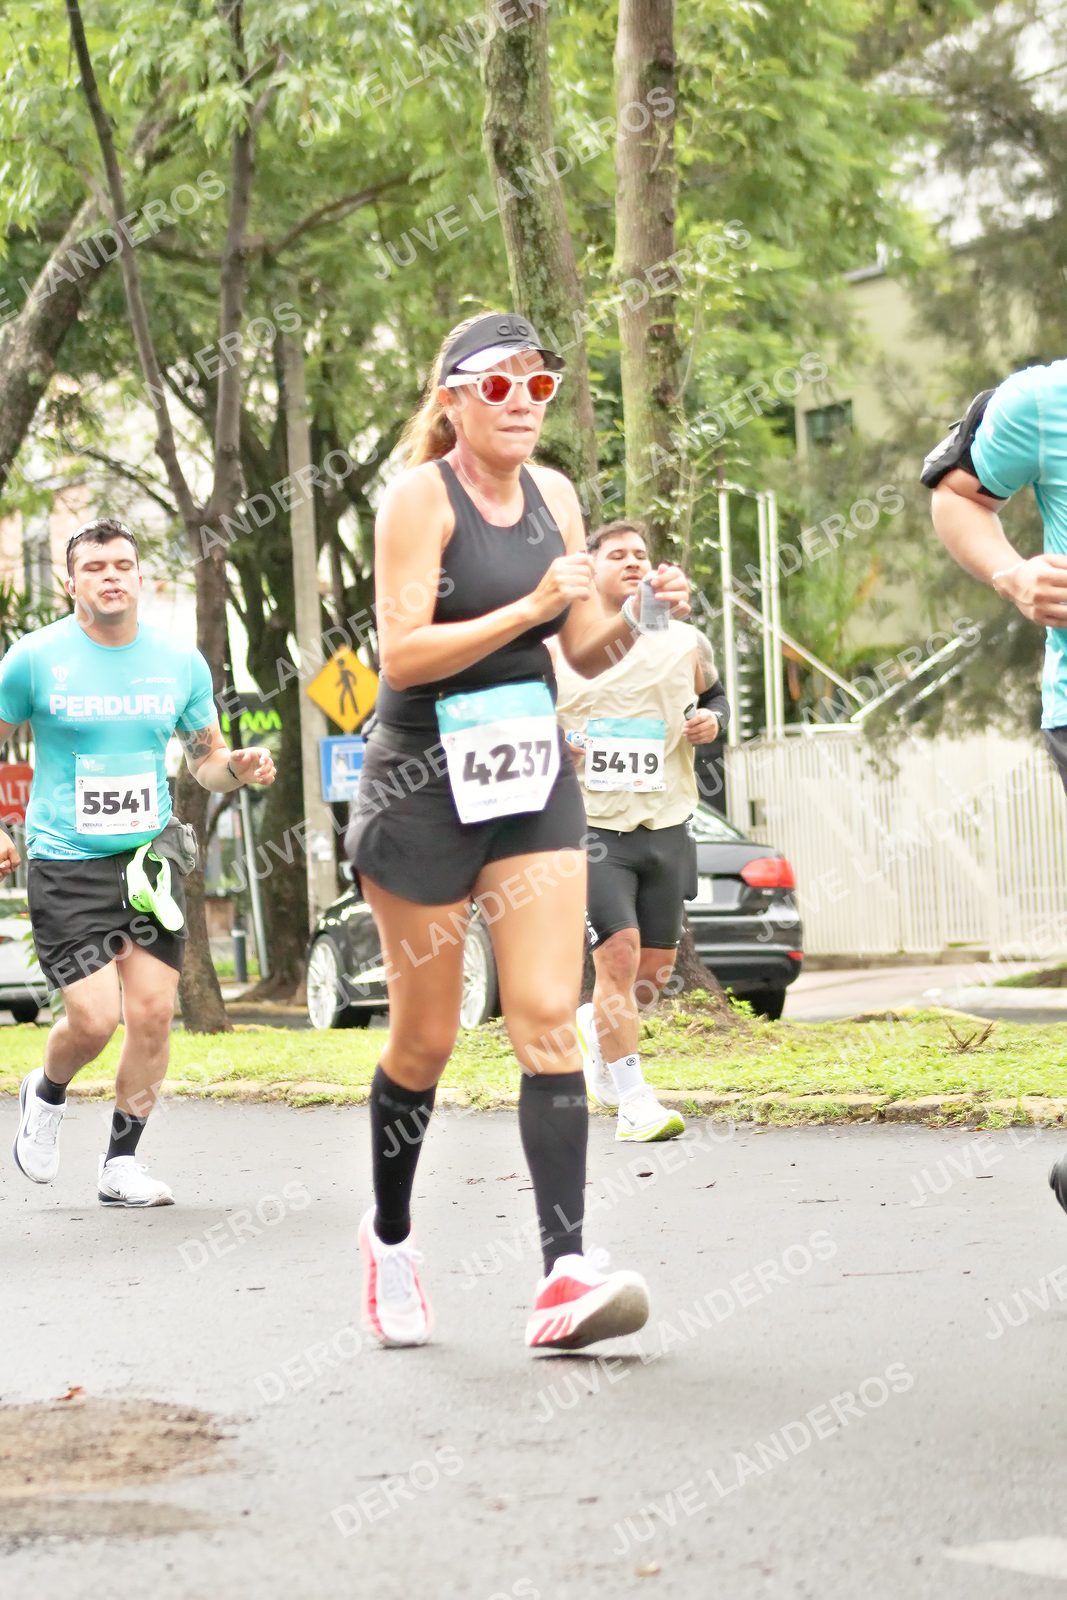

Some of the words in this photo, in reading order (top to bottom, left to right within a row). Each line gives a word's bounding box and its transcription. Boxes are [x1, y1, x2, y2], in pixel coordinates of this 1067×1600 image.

[49, 694, 176, 717] PERDURA
[463, 740, 552, 786] 4237
[591, 751, 659, 775] 5419
[82, 788, 151, 816] 5541
